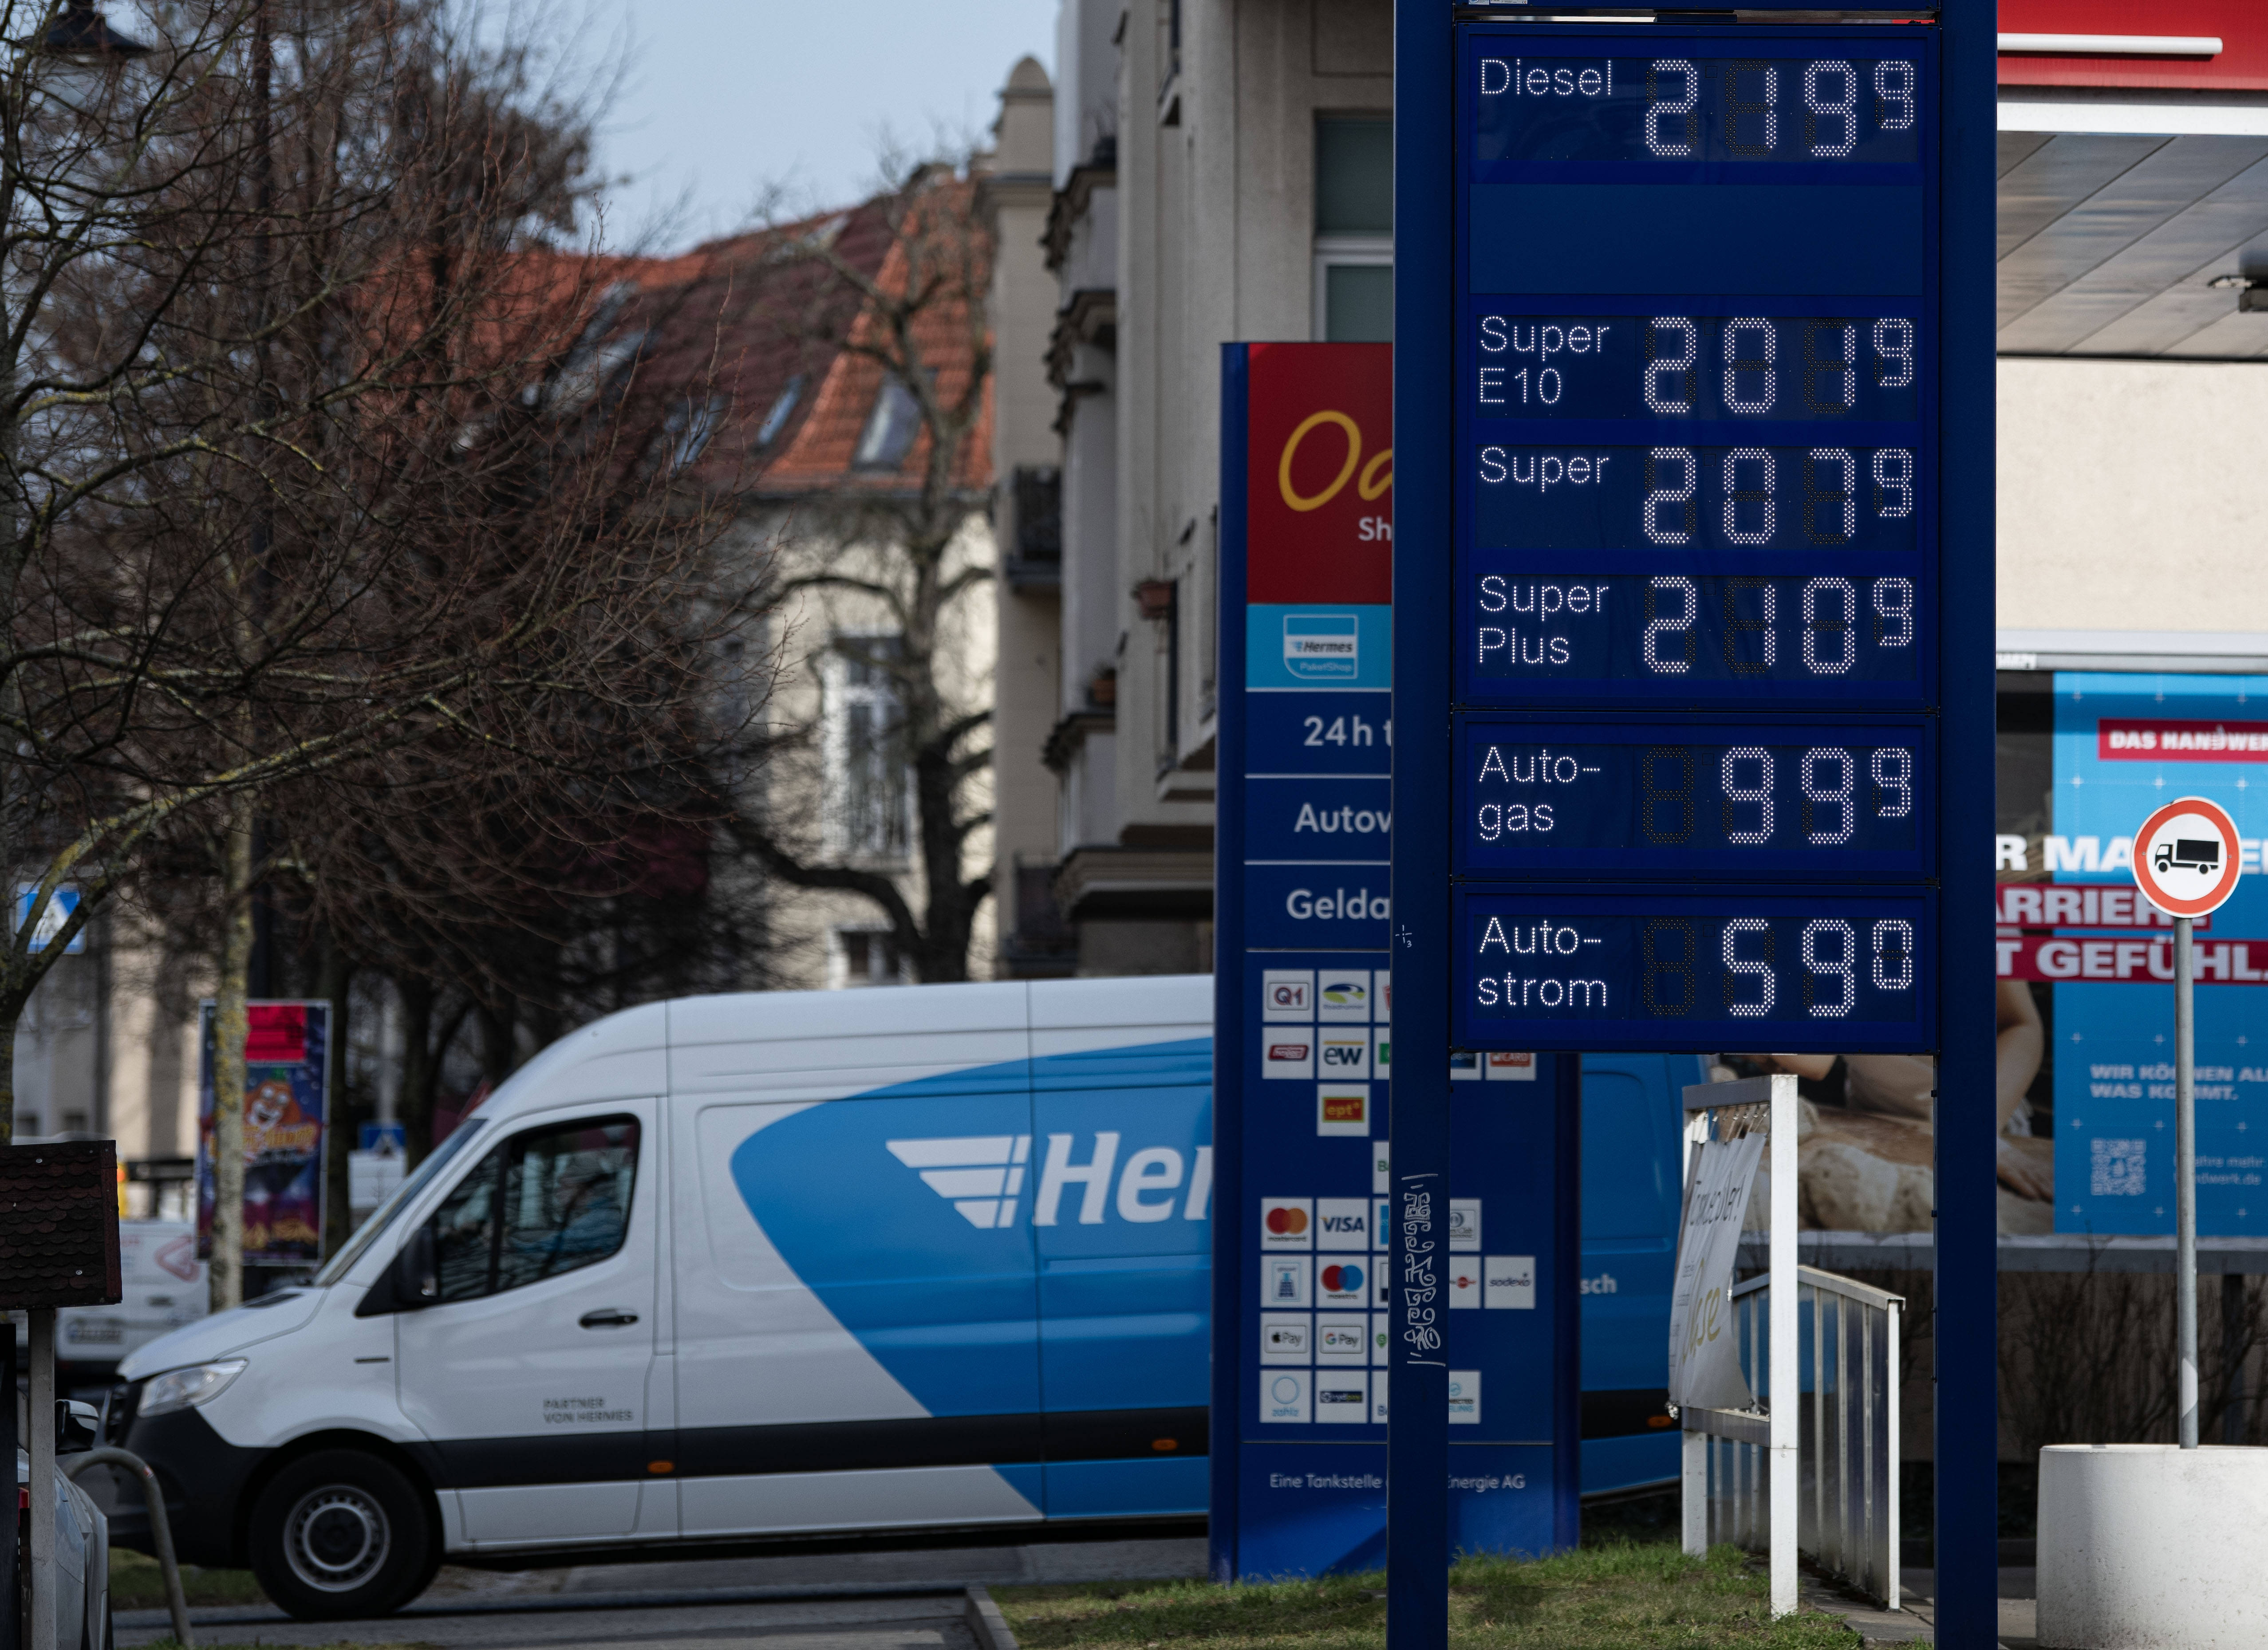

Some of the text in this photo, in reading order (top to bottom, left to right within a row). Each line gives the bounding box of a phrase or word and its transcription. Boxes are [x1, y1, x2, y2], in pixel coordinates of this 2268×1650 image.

[1482, 59, 1611, 95] Diesel
[1481, 316, 1609, 361] Super
[1480, 368, 1561, 404] E10
[1480, 447, 1609, 492] Super
[1480, 576, 1609, 621] Super
[1303, 642, 1353, 653] Hermes
[1479, 628, 1569, 664] Plus
[2109, 730, 2157, 750] DAS
[1479, 747, 1600, 783] Auto-
[1479, 804, 1554, 841] gas
[1479, 917, 1601, 954] Auto-
[1274, 987, 1302, 1005] Q1
[1479, 972, 1606, 1006] strom
[1324, 1047, 1362, 1065] ew
[2090, 1065, 2134, 1080] WIR
[2090, 1083, 2142, 1099] WAS
[1321, 1217, 1365, 1233] VISA
[1282, 1332, 1302, 1346] Pay
[1339, 1334, 1357, 1347] Pay
[543, 1398, 604, 1409] PARTNER
[543, 1409, 633, 1423] VON HERMES
[1270, 1473, 1303, 1488] Eine
[1306, 1473, 1383, 1488] Tankstelle
[1448, 1474, 1526, 1492] nergie AG
